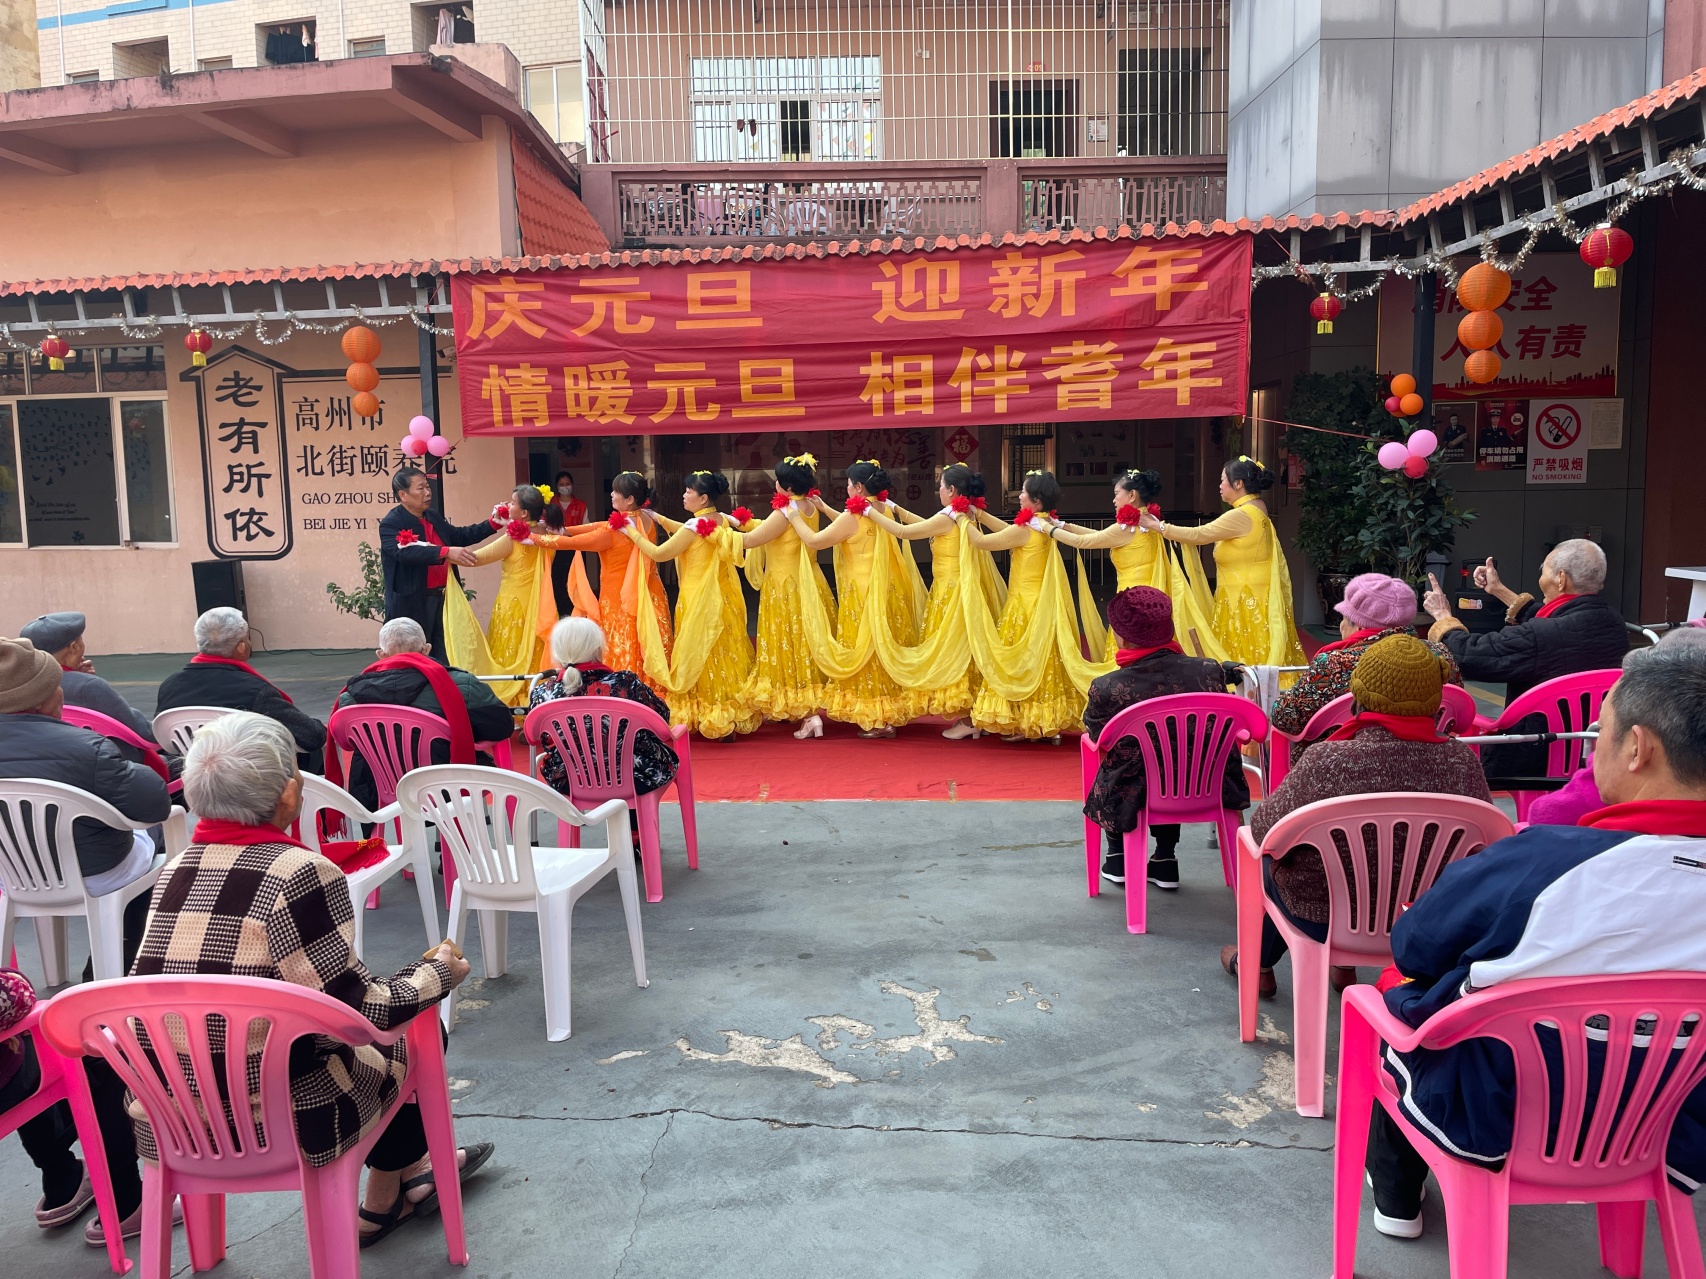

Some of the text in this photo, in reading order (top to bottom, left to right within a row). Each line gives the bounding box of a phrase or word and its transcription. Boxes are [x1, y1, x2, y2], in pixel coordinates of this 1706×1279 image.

[466, 245, 1208, 340] 庆元旦 迎新年
[481, 337, 1223, 428] 情暖元旦 相伴耆年
[951, 434, 971, 454] 福
[214, 370, 275, 543] 老有所依
[1532, 457, 1583, 472] 严禁吸烟
[301, 492, 331, 504] GAO
[334, 492, 373, 504] ZHOU
[303, 518, 326, 530] BEI
[329, 518, 351, 530] JIE
[354, 518, 367, 530] YI
